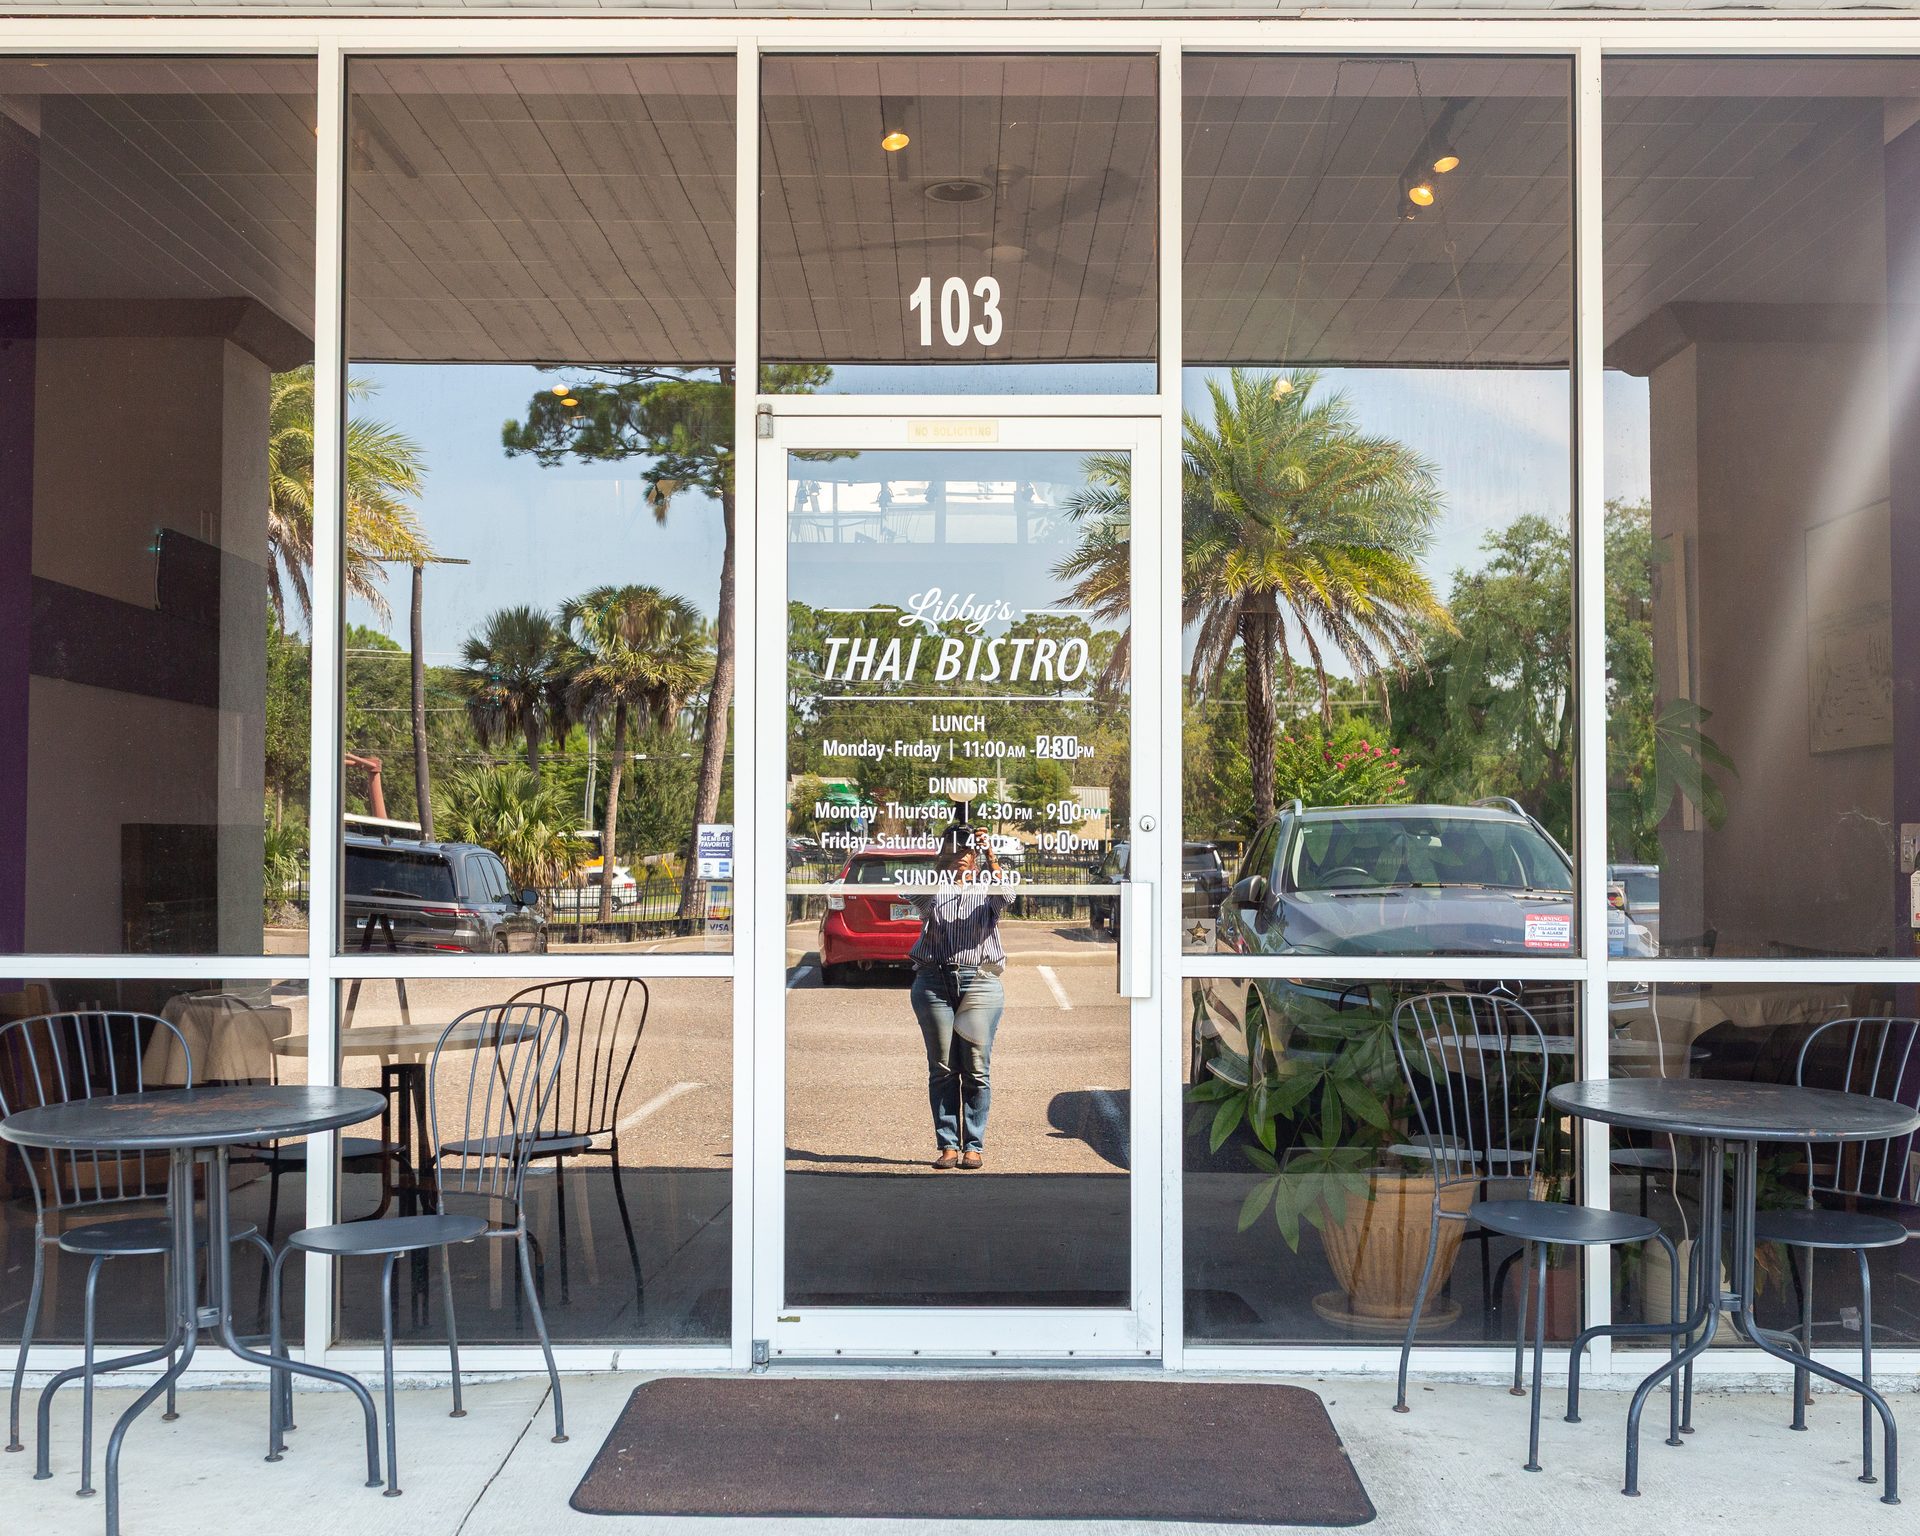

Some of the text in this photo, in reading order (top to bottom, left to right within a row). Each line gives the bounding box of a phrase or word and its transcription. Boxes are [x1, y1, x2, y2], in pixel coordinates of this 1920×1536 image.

[909, 276, 1003, 346] 103
[915, 426, 992, 437] NO SOLICITING
[898, 587, 1014, 634] Libby's
[823, 637, 1090, 682] THAI BISTRO
[932, 715, 985, 732] LUNCH
[929, 777, 988, 794] DINNER
[894, 869, 957, 886] SUNDAY
[961, 869, 1021, 887] CLOSED
[710, 923, 729, 931] VISA
